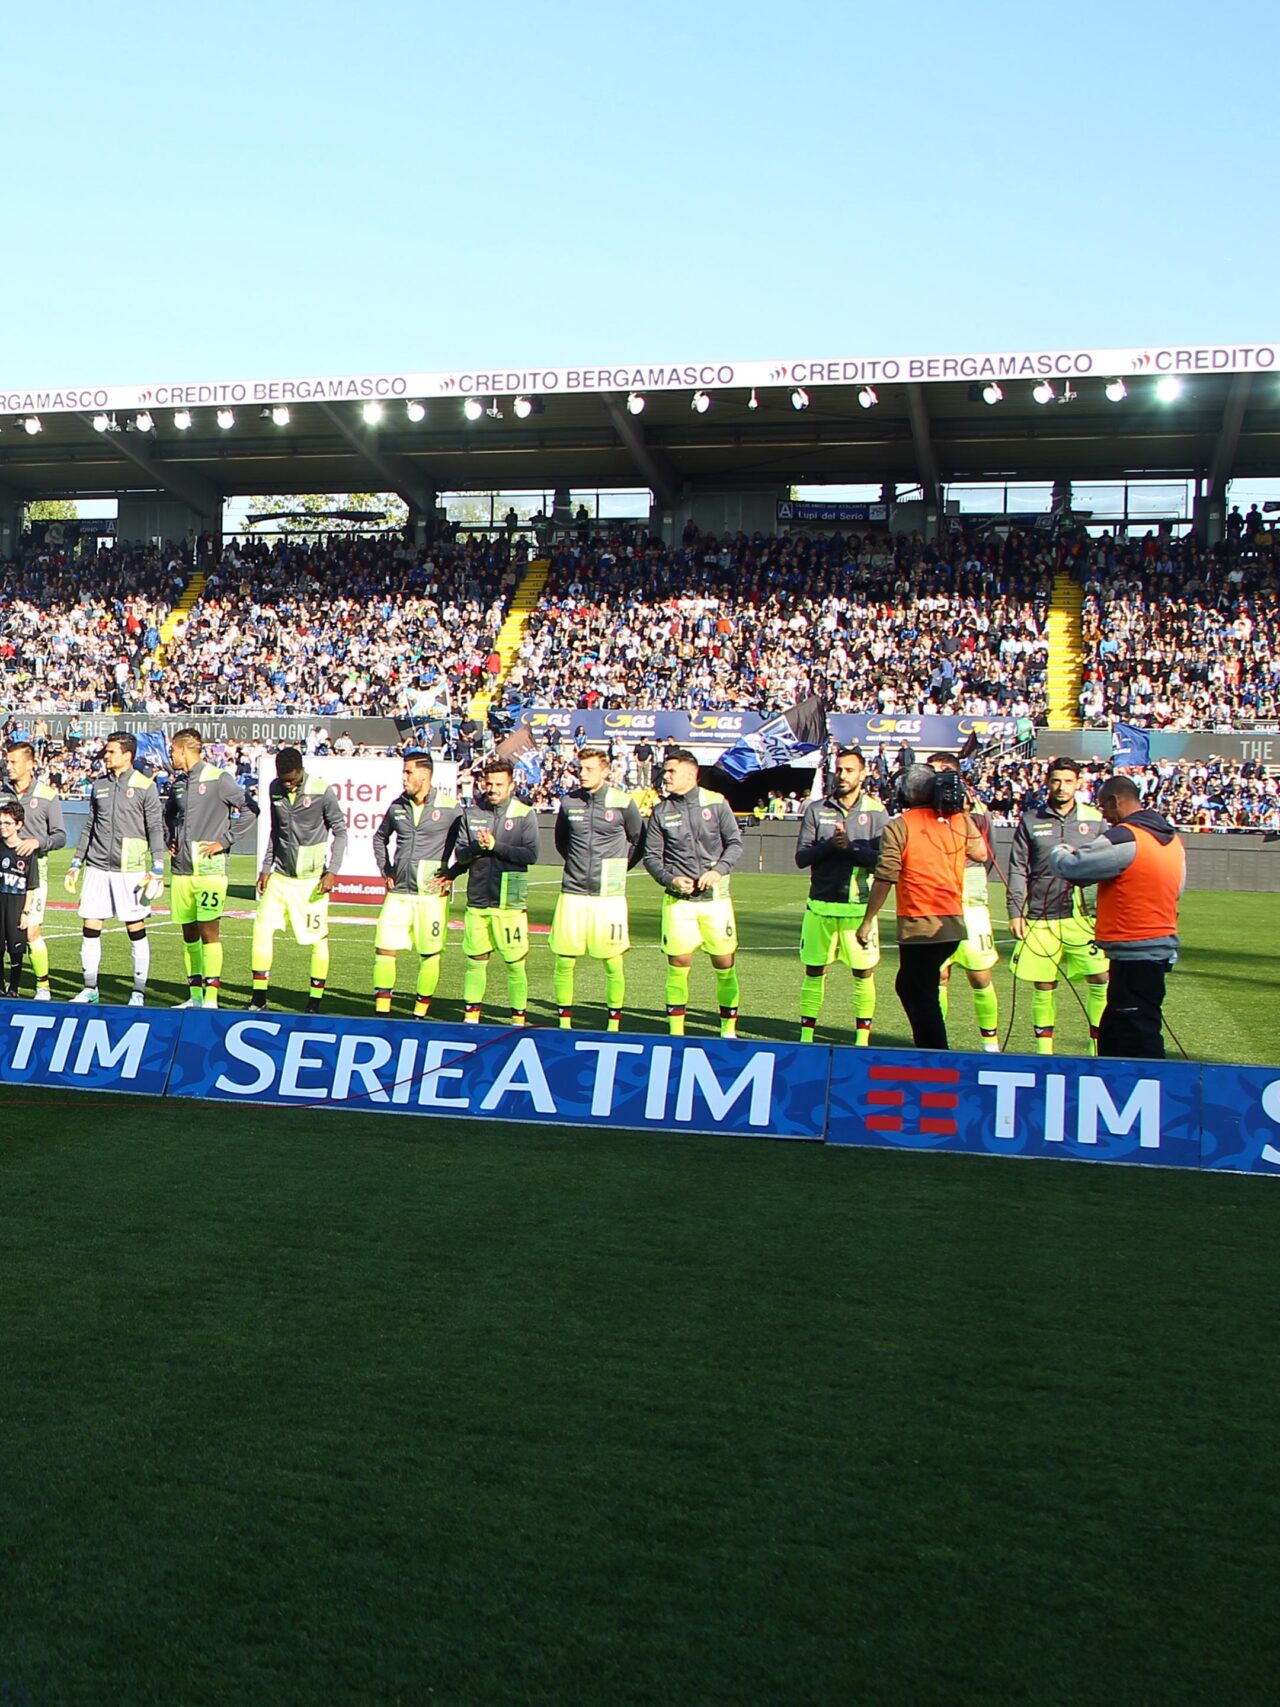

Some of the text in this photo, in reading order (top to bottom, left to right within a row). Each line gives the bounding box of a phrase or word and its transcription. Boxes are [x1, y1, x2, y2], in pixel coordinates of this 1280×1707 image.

[1155, 348, 1274, 370] CREDITO
[791, 354, 1093, 383] CREDITO BERGAMASCO
[458, 366, 735, 392] CREDITO BERGAMASCO
[155, 377, 407, 405] CREDITO BERGAMASCO
[798, 511, 864, 521] Lupi del Serio
[547, 713, 572, 727] GLS
[631, 714, 656, 728] GLS
[717, 716, 743, 730] GLS
[894, 719, 922, 734] GLS
[124, 722, 148, 736] TIM
[1240, 740, 1273, 760] THE
[332, 778, 387, 802] nter
[343, 807, 385, 830] den
[331, 884, 386, 896] -hotel.com
[200, 891, 219, 908] 25
[305, 914, 321, 930] 15
[431, 920, 441, 937] 8
[725, 921, 734, 938] 6
[504, 926, 522, 944] 14
[609, 924, 624, 941] 11
[978, 933, 993, 951] 10
[10, 1014, 150, 1079] TIM
[214, 1020, 776, 1126] SERIE A TIM
[978, 1070, 1160, 1148] TIM
